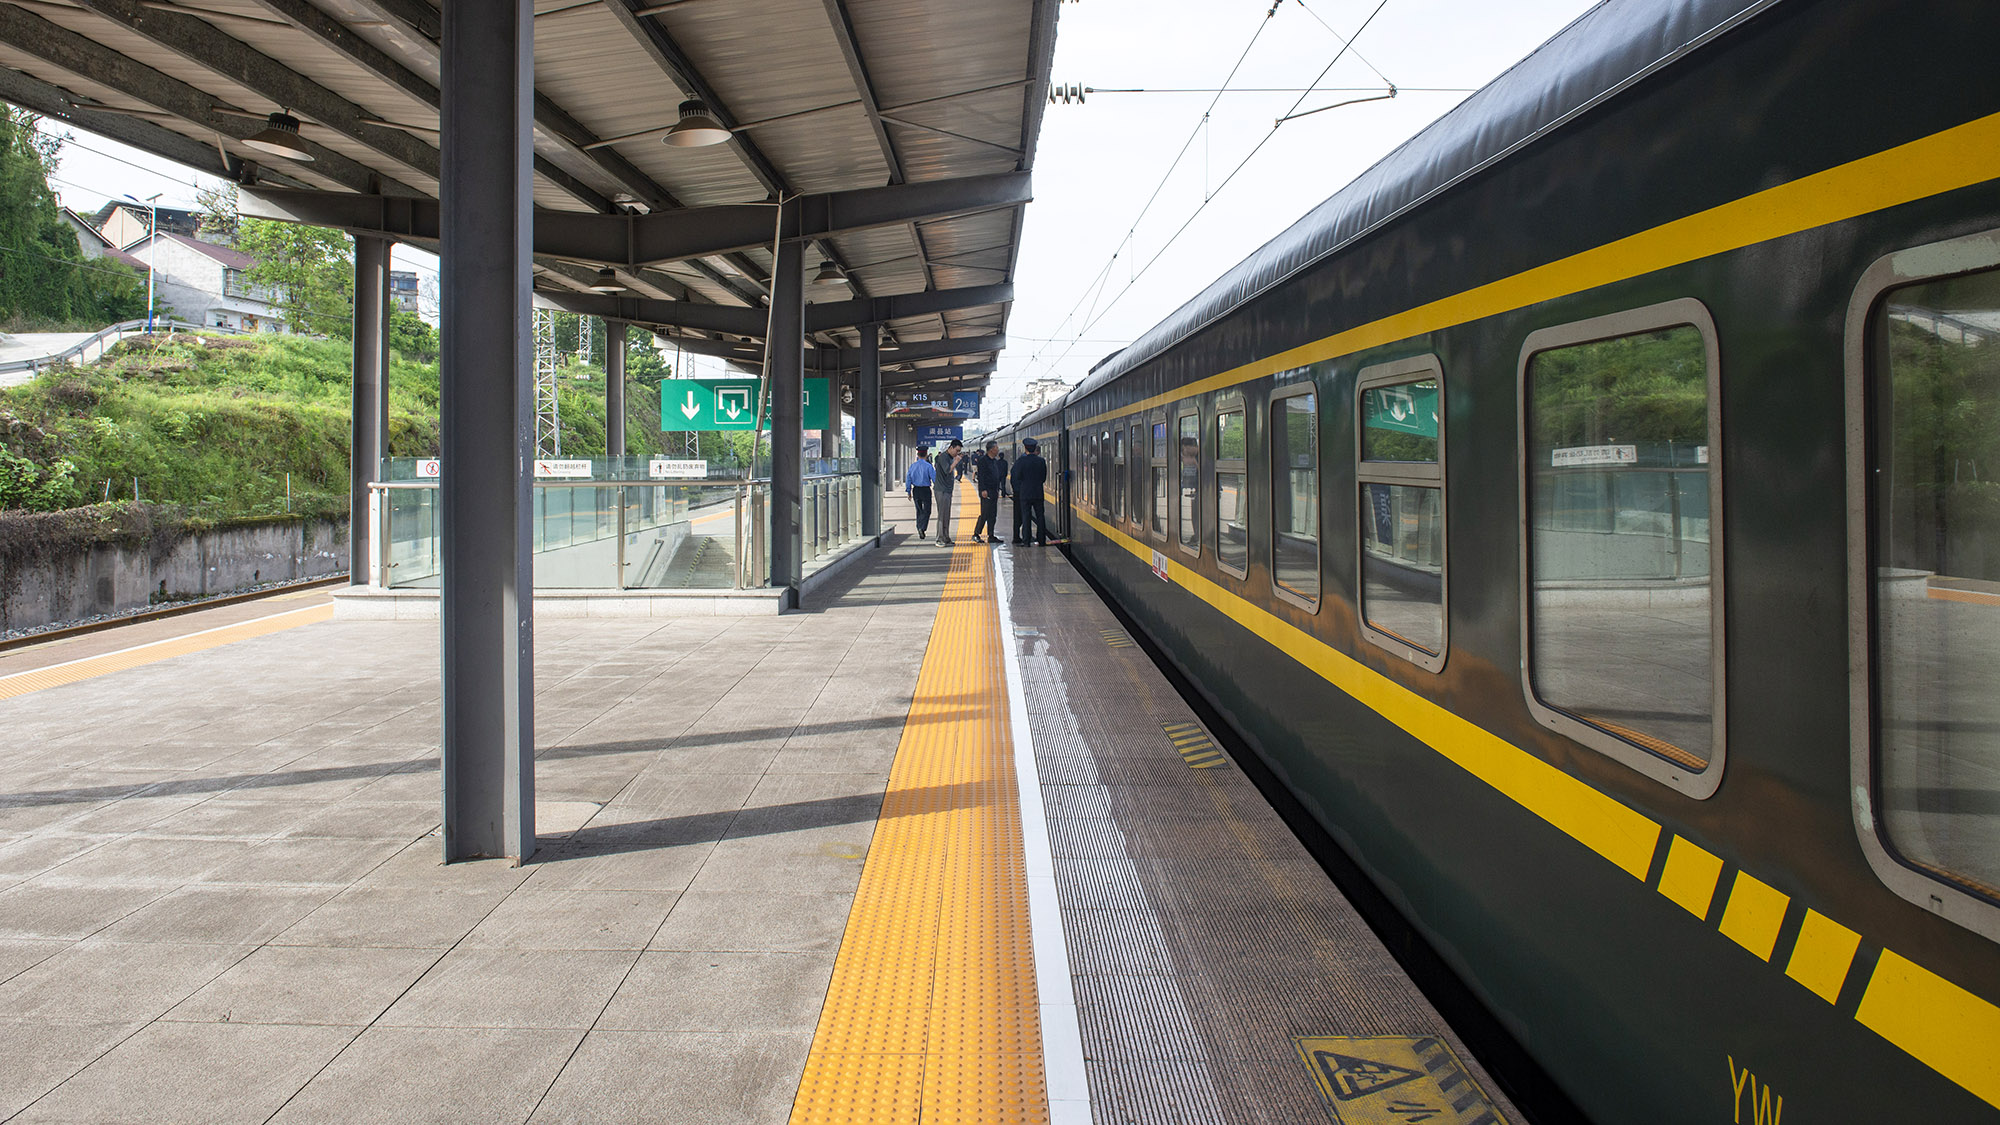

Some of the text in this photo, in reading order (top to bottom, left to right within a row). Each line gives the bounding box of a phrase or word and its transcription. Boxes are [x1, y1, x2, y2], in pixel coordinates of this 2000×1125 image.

[929, 427, 952, 435] 渠县站
[1727, 1054, 1783, 1125] YW
